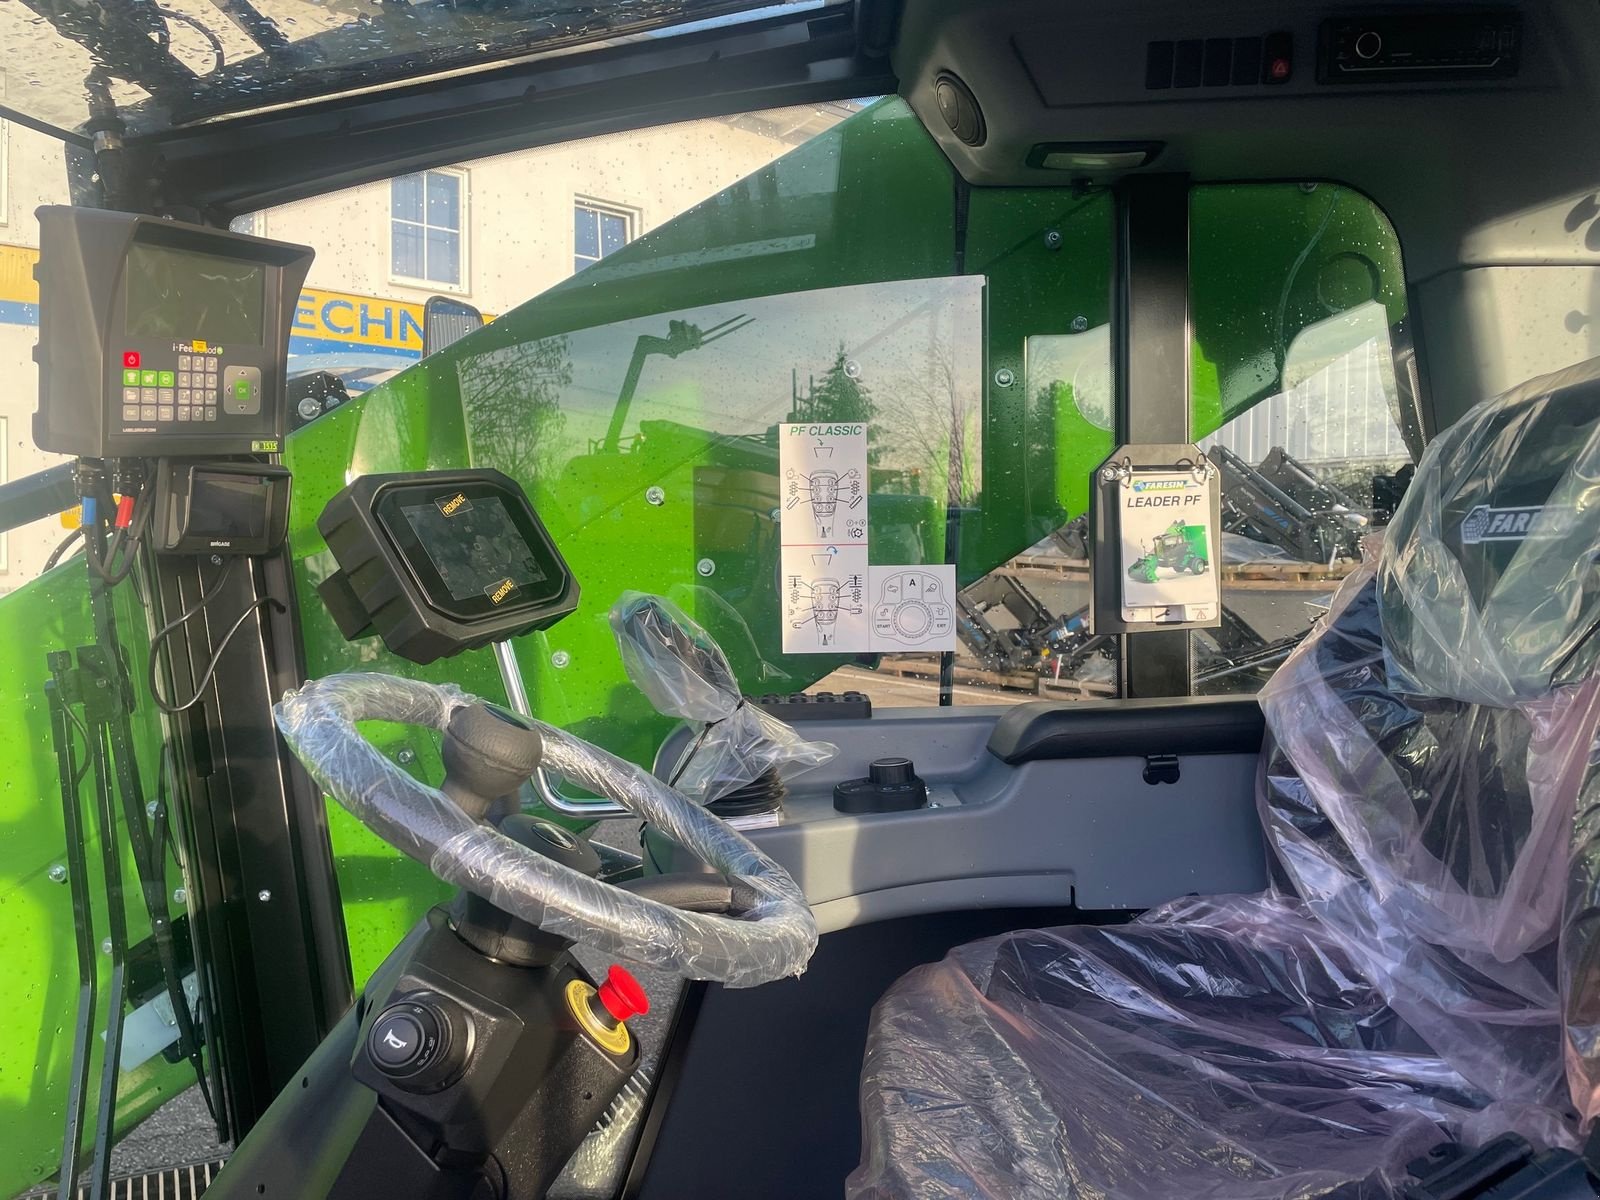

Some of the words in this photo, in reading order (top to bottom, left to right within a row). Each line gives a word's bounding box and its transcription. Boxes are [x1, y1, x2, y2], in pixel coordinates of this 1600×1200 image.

[790, 425, 806, 436] PF
[809, 425, 862, 436] CLASSIC
[1145, 481, 1184, 489] FARESIN
[442, 493, 466, 515] REMOVE
[1127, 496, 1180, 507] LEADER
[1184, 495, 1202, 506] PF
[909, 578, 916, 587] A
[491, 579, 515, 603] REMOVE
